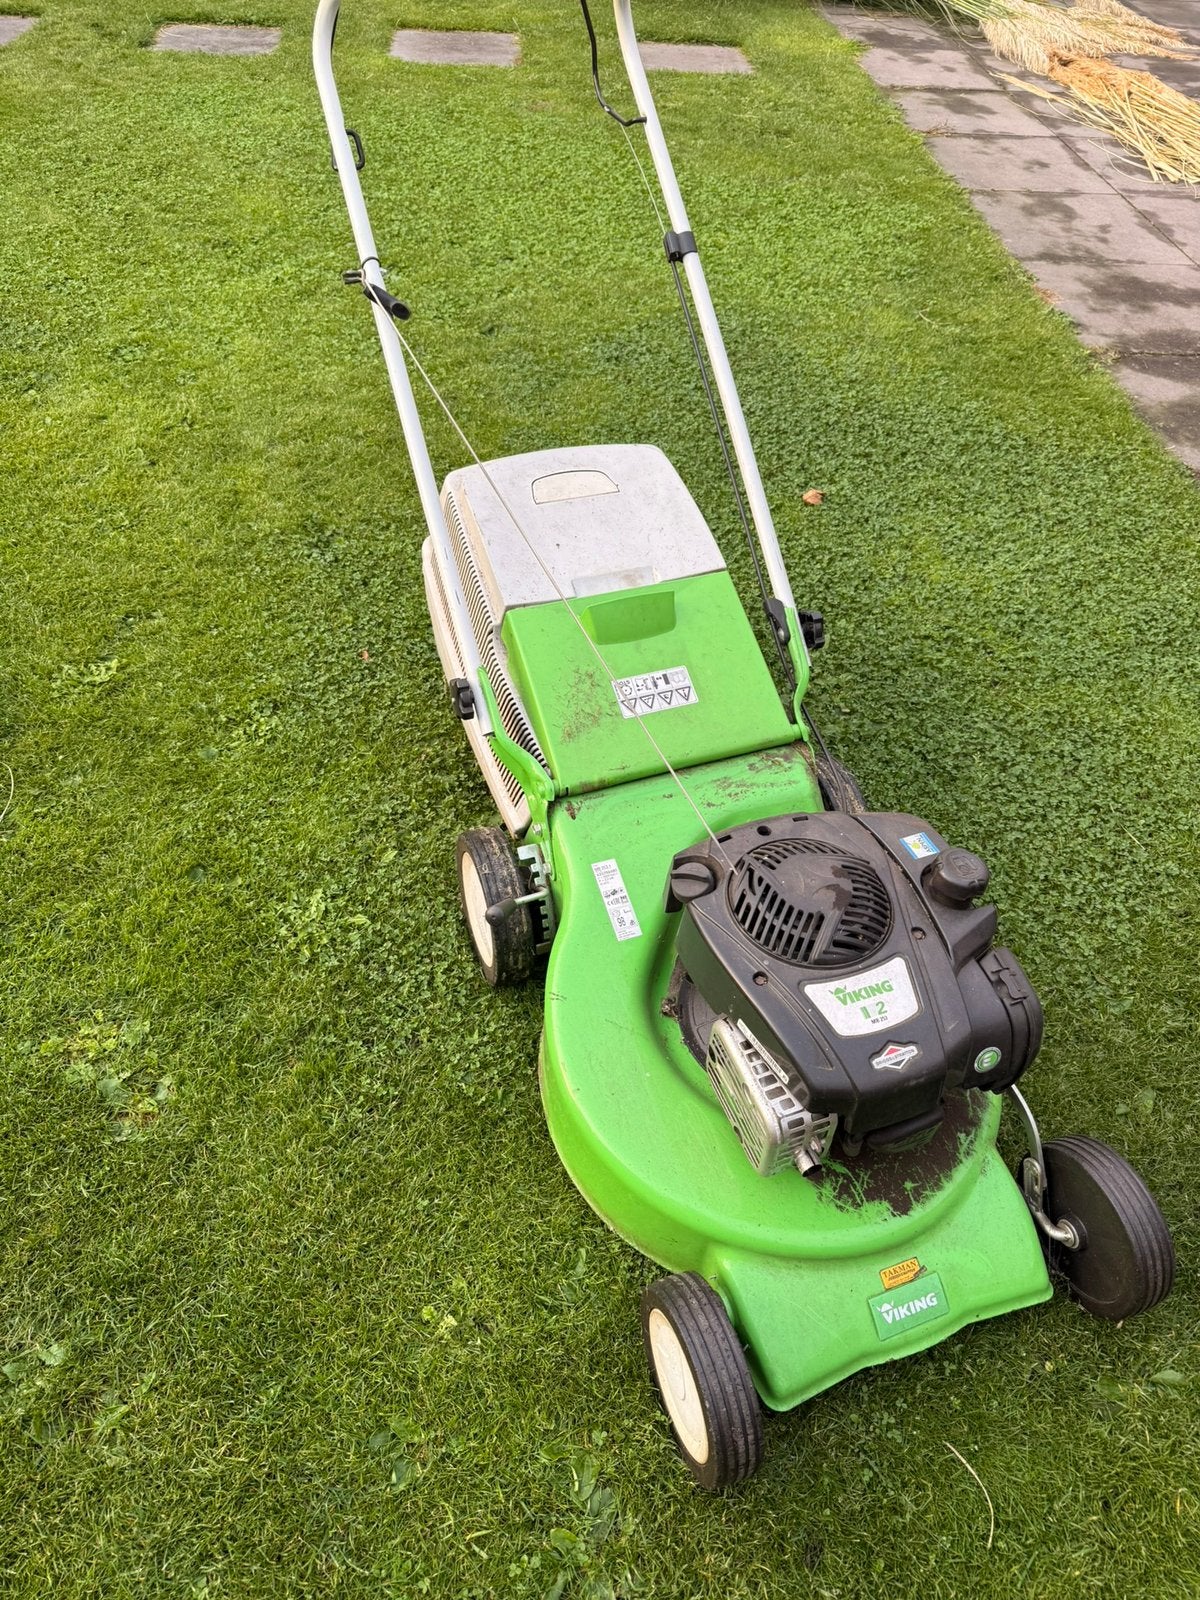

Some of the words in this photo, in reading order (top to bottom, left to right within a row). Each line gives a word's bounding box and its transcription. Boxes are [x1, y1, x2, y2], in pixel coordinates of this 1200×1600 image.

[835, 980, 895, 1006] VIKING
[875, 1001, 888, 1015] 2
[882, 1260, 918, 1279] TAKMAN
[882, 1292, 938, 1325] VIKING
